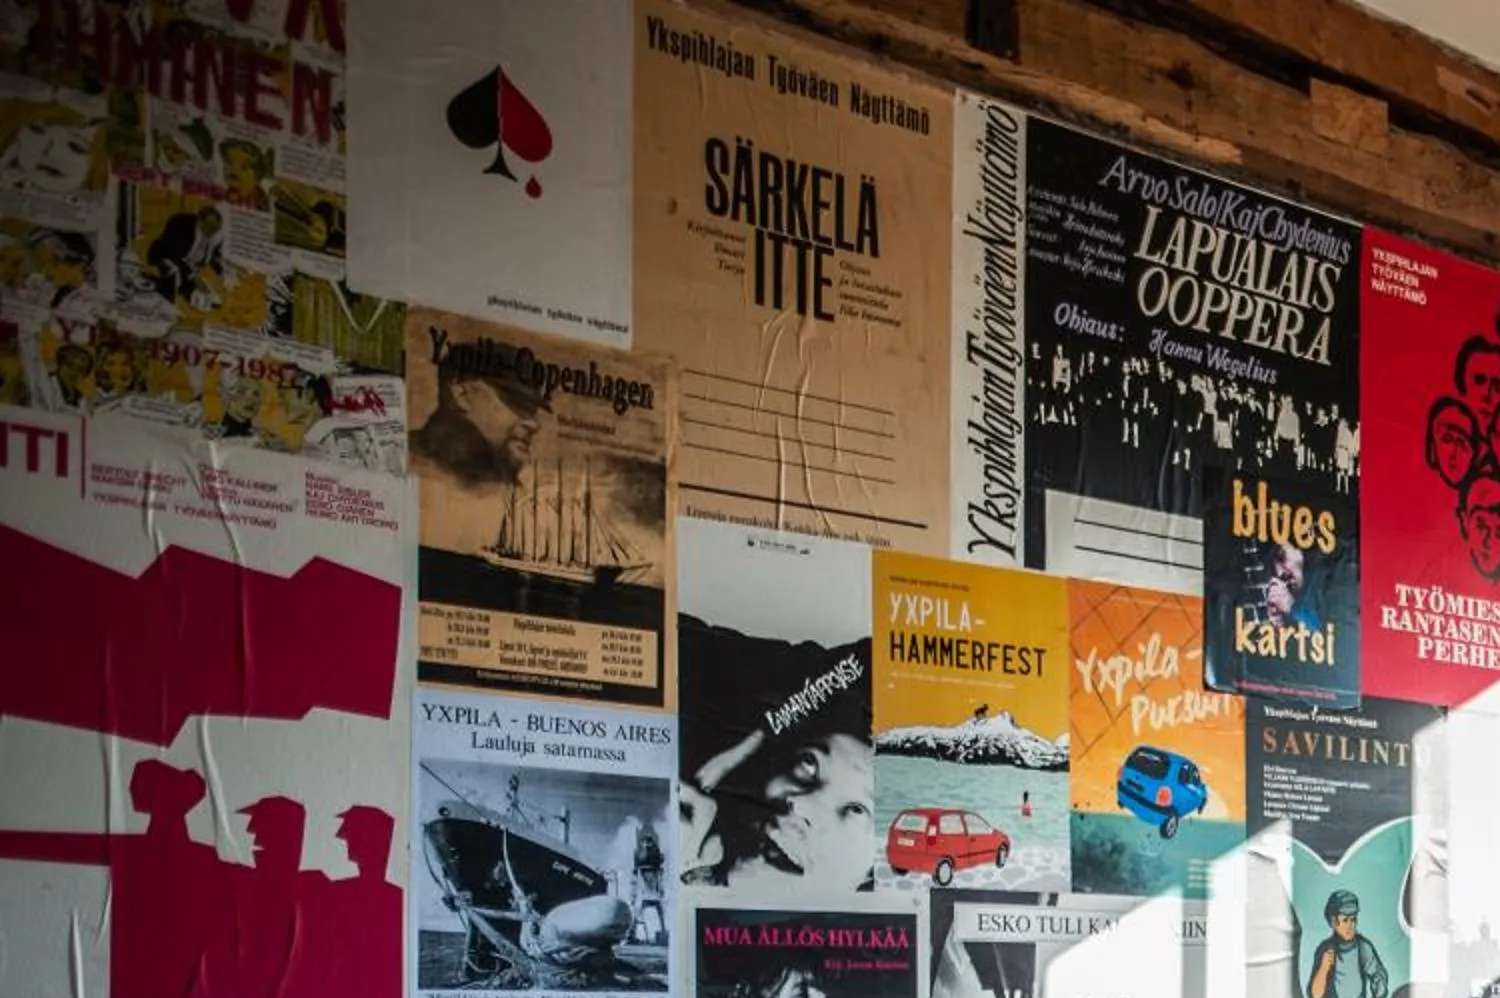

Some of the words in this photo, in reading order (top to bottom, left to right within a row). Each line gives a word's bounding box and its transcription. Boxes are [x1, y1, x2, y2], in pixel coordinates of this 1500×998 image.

[768, 53, 840, 108] Työväen
[850, 81, 930, 137] Näyttämö
[704, 134, 881, 259] SÄRKELÄ
[1099, 155, 1168, 204] Arvo
[753, 227, 836, 323] ITTE
[1134, 204, 1342, 313] LAPUALAIS
[1053, 301, 1126, 343] Ohjaus:
[1206, 343, 1280, 386] Wegelius
[1137, 265, 1332, 366] OOPPERA
[1232, 479, 1337, 554] blues
[890, 630, 1047, 678] HAMMERFEST
[1235, 606, 1335, 665] kartsi
[421, 703, 501, 727] YXPILA
[527, 714, 606, 739] BUENOS
[614, 725, 671, 746] AIRES
[471, 731, 536, 757] Lauluja
[543, 741, 626, 762] satamassa
[704, 927, 752, 947] MUA
[758, 924, 824, 948] ÄLLÖS
[828, 928, 909, 949] HYLKÄÄ
[978, 912, 1031, 934] ESKO
[1039, 915, 1083, 936] TULI
